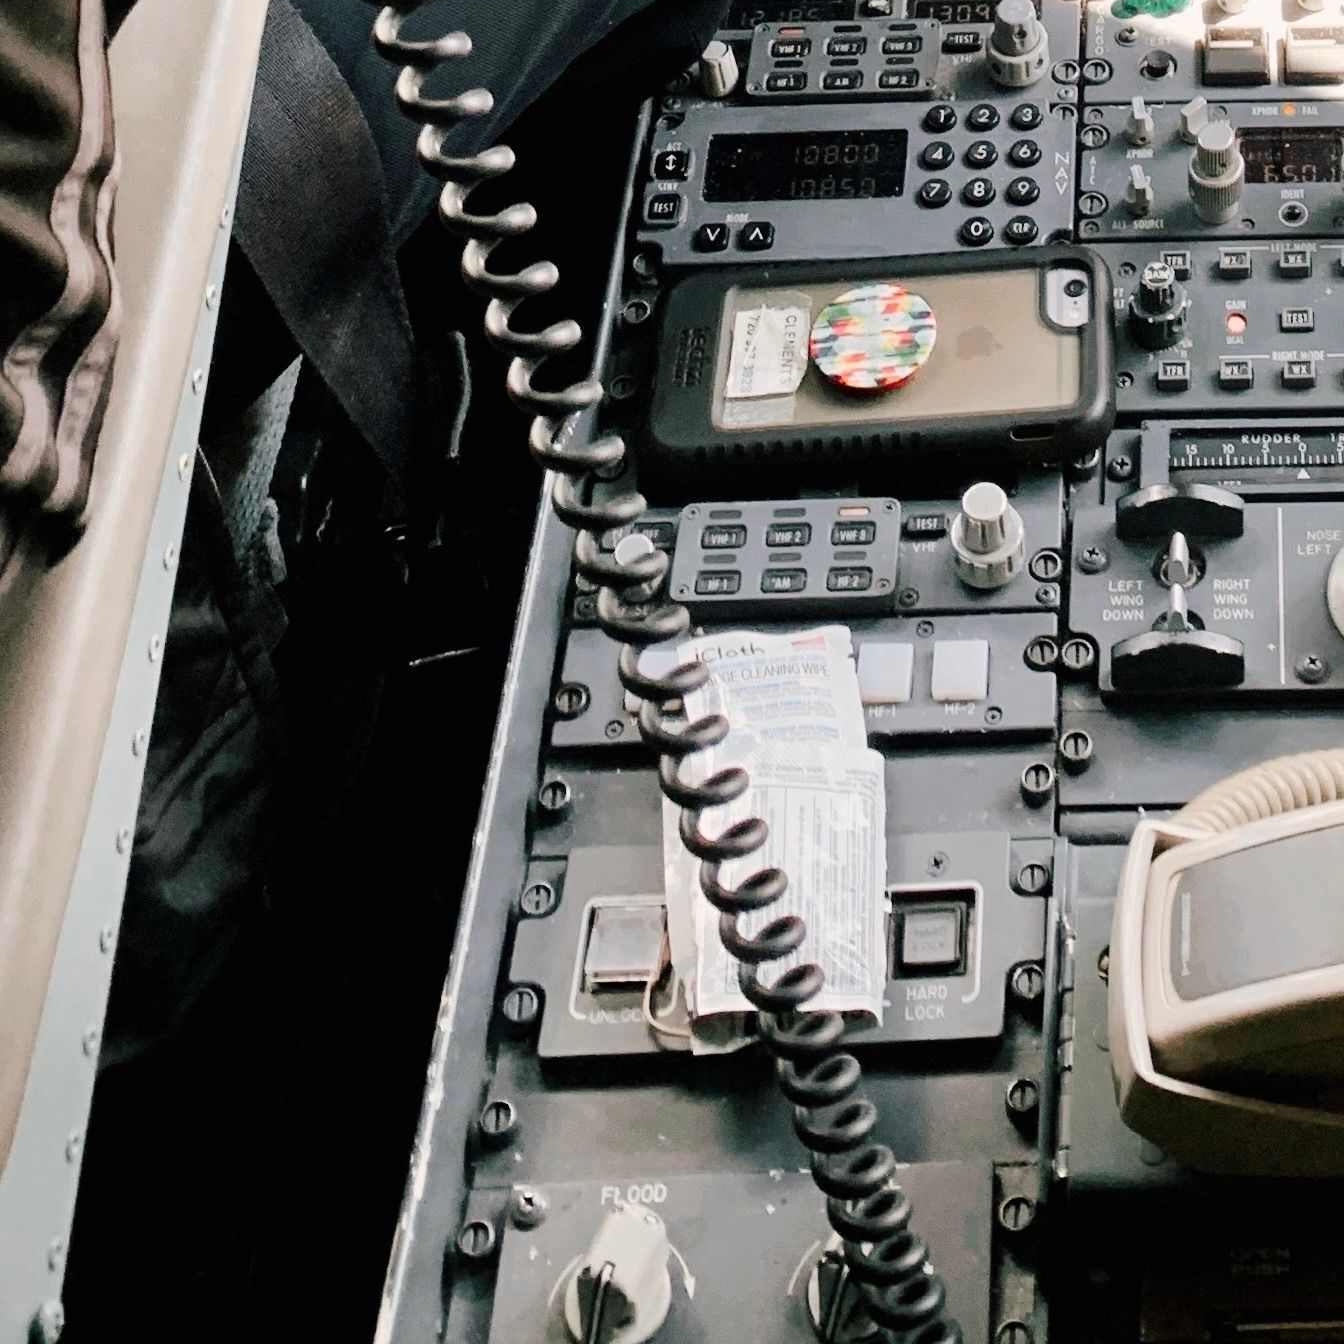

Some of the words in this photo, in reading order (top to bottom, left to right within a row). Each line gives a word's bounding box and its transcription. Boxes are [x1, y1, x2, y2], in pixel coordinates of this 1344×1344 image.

[1241, 433, 1301, 444] RUDDER
[1307, 529, 1341, 541] NOSE
[1297, 544, 1331, 556] LEFT
[1108, 580, 1143, 592] LEFT
[1213, 579, 1251, 591] RIGHT
[1110, 594, 1144, 606] WING
[1213, 594, 1248, 605] WING
[1102, 609, 1144, 621] DOWN
[1213, 608, 1254, 620] DOWN
[695, 643, 765, 663] iCloth
[741, 664, 800, 680] CLEANING
[802, 662, 829, 677] WIPE
[906, 986, 948, 1001] HARD
[905, 1005, 946, 1021] LOCK
[601, 1184, 667, 1206] FLOOD
